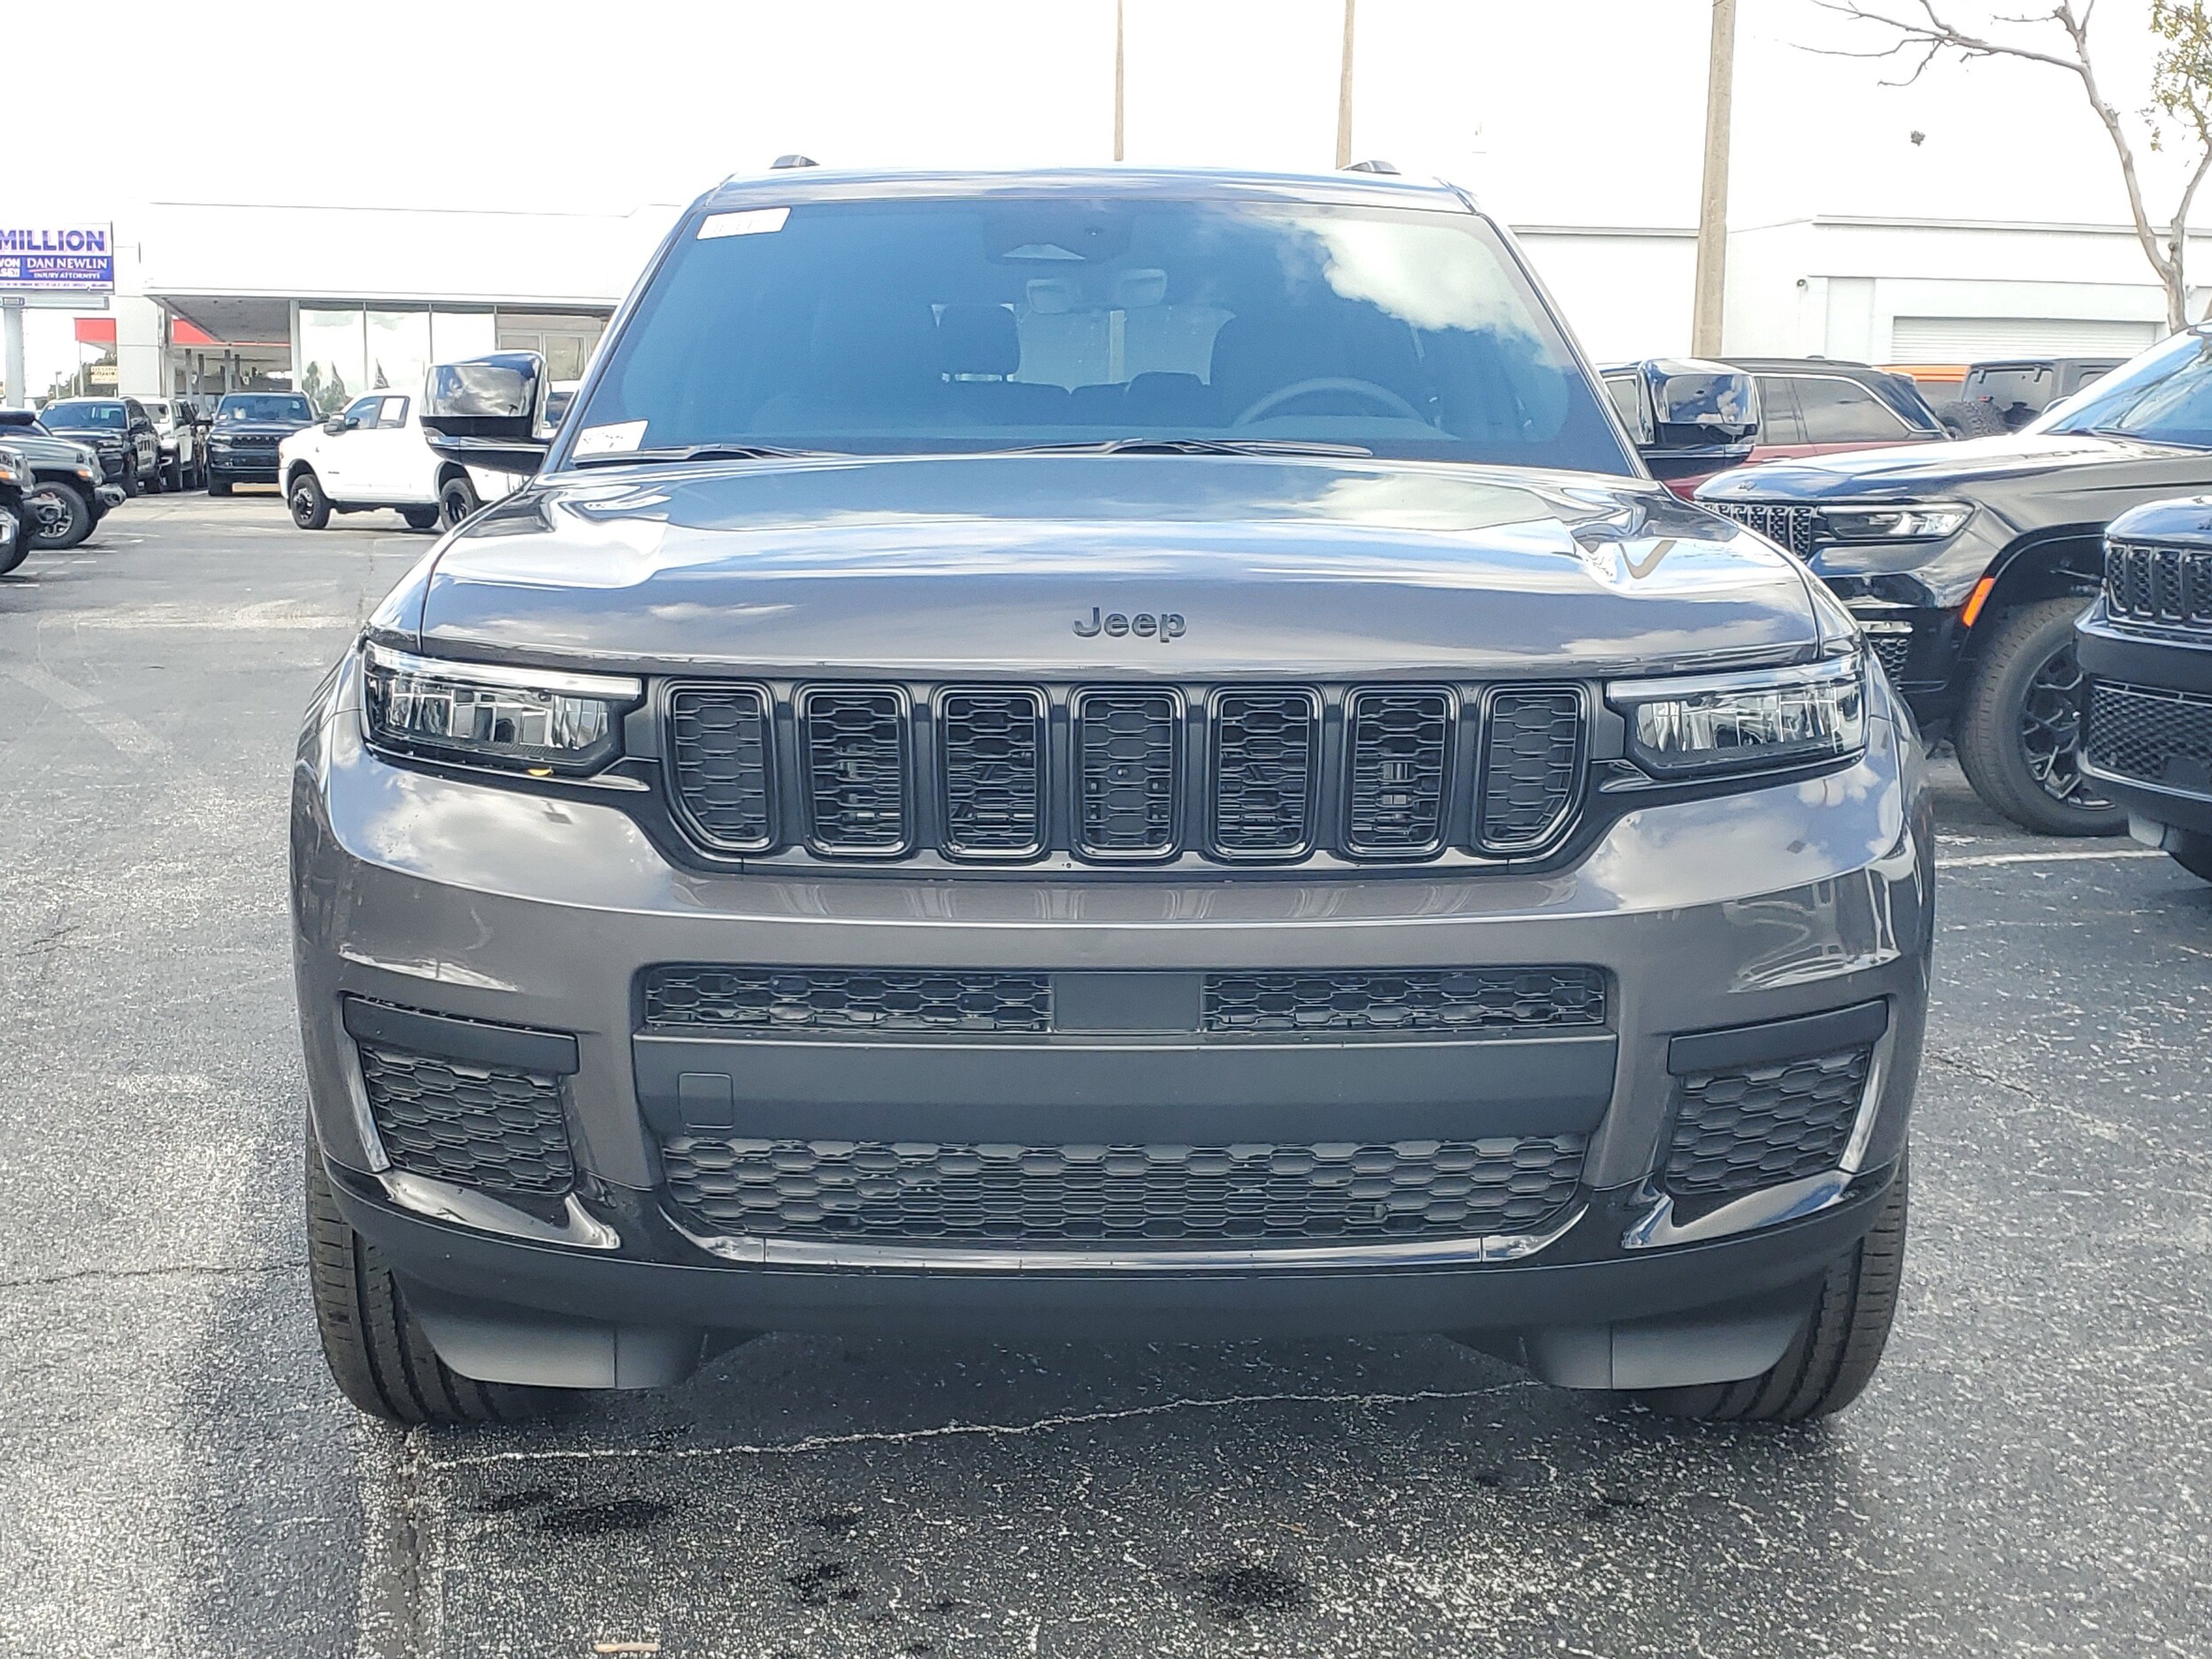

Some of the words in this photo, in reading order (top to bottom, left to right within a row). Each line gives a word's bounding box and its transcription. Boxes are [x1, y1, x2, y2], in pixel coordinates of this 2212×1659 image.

[0, 230, 104, 251] MILLION
[27, 257, 53, 268] DAN
[57, 257, 107, 269] NEWLIN
[1072, 607, 1187, 643] Jeep
